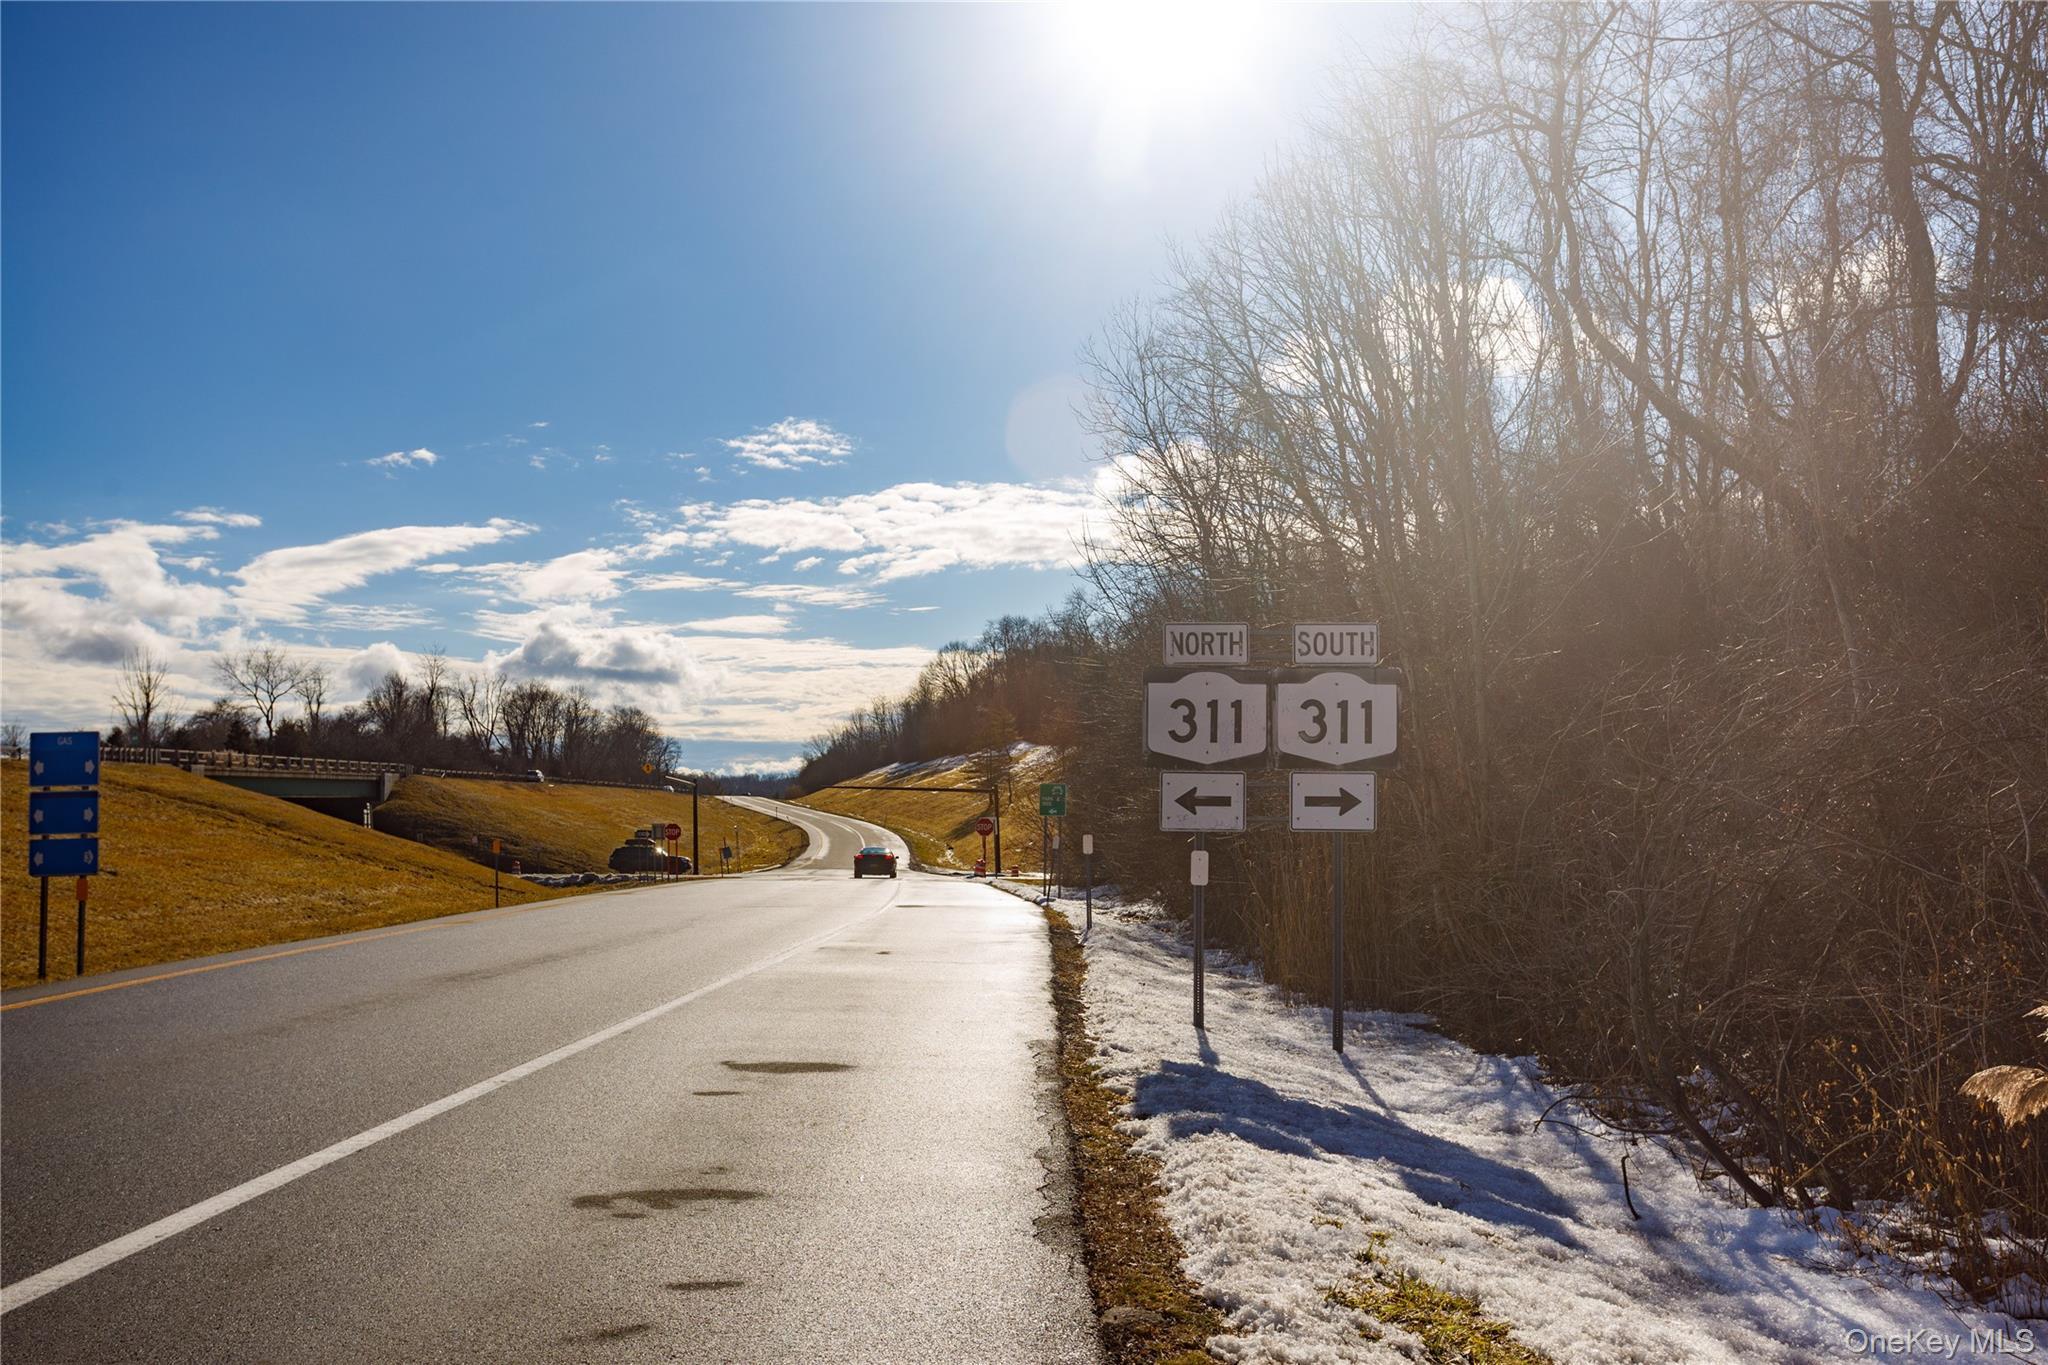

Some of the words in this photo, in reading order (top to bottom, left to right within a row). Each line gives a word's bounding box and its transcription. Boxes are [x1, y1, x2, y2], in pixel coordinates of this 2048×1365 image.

[1170, 631, 1243, 656] NORTH
[1298, 631, 1375, 656] SOUTH
[1168, 698, 1243, 744] 311
[1298, 699, 1373, 744] 311
[57, 736, 73, 745] GAS
[976, 823, 992, 831] STOP
